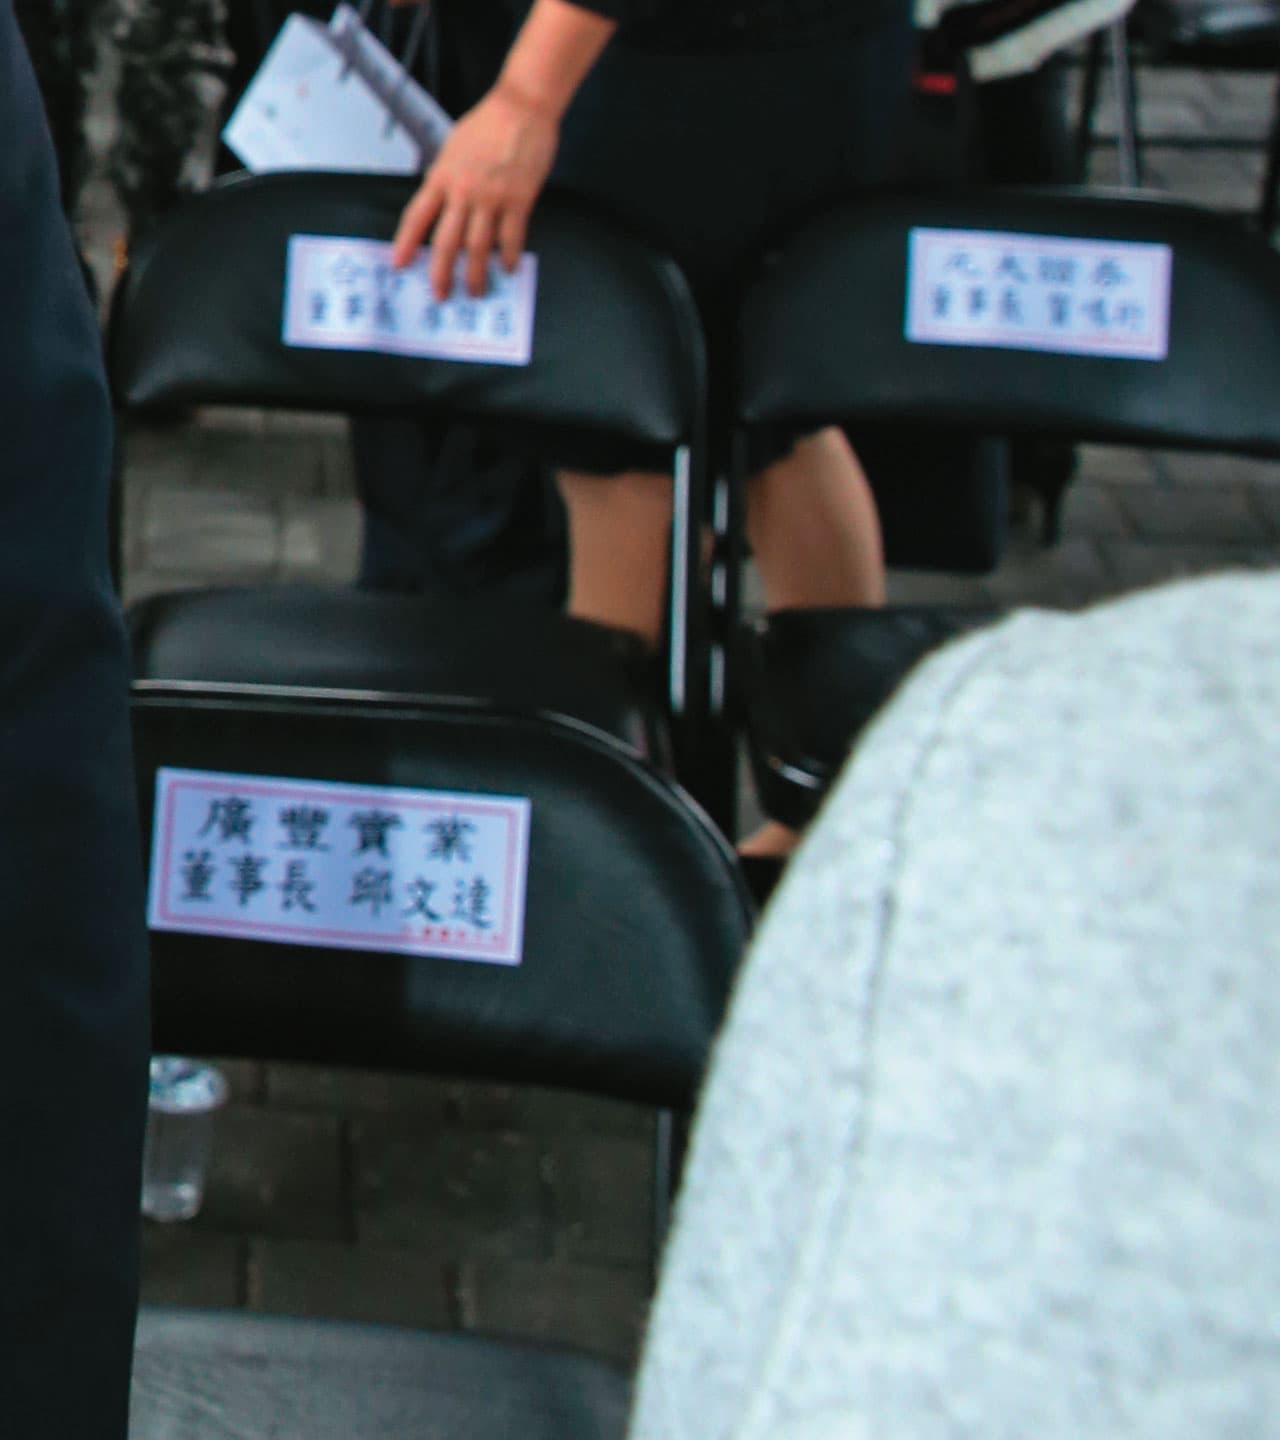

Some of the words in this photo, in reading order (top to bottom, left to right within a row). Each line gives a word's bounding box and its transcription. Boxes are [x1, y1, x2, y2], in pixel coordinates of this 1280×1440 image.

[196, 793, 480, 864] 廣豐實業
[178, 848, 319, 914] 董事長
